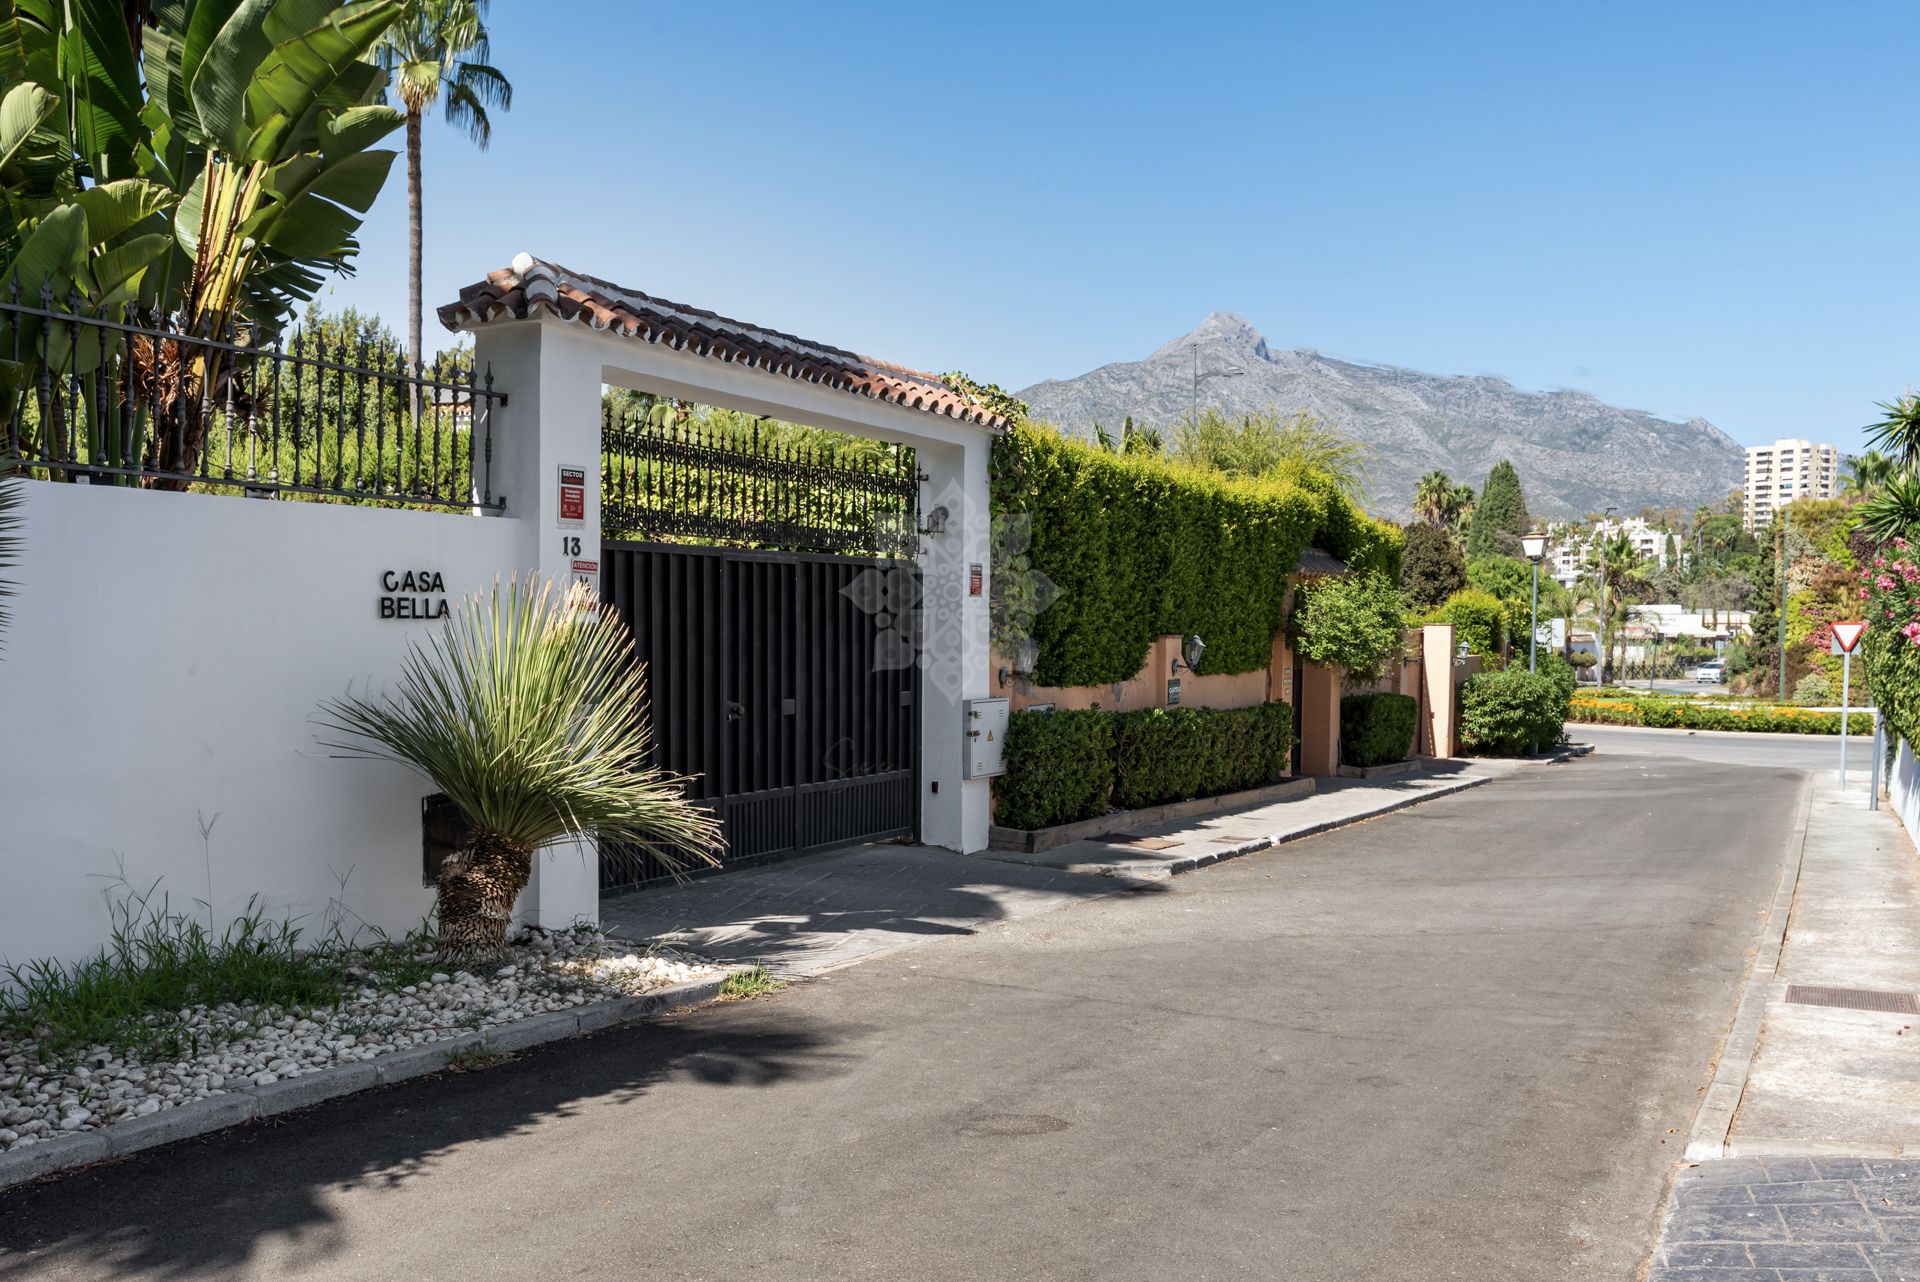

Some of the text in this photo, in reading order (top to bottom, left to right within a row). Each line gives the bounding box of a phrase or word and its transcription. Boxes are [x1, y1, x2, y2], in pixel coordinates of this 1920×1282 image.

[562, 470, 584, 479] SECTOR
[563, 536, 581, 556] 13
[383, 570, 446, 593] CASA
[380, 597, 451, 619] BELLA
